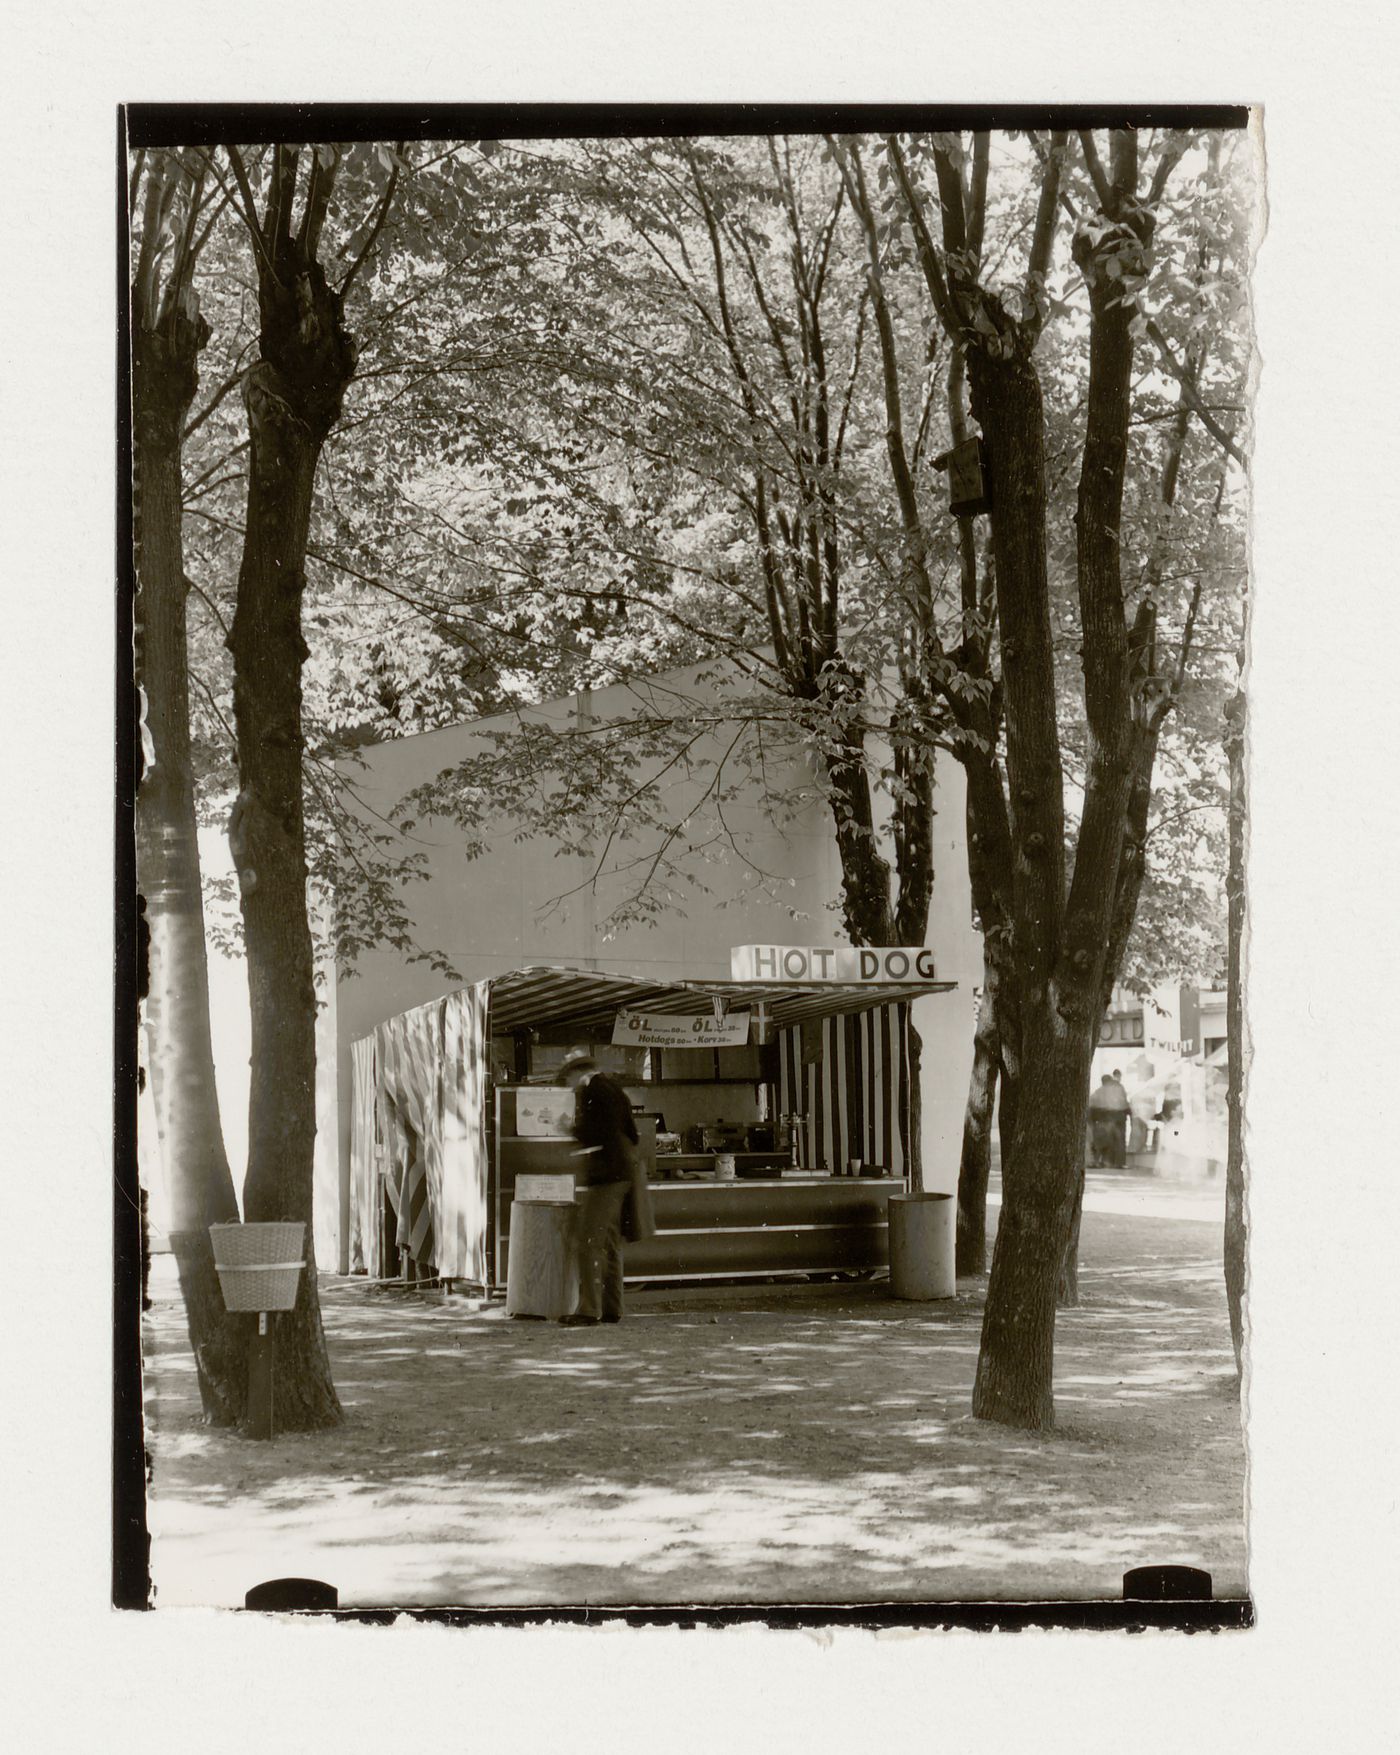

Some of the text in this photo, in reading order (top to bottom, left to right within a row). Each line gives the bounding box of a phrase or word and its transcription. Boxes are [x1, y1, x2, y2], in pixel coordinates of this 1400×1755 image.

[755, 948, 935, 979] HOT DOG
[628, 1015, 652, 1032] ÖL
[692, 1017, 713, 1032] ÖL
[638, 1034, 676, 1046] Hotdogs
